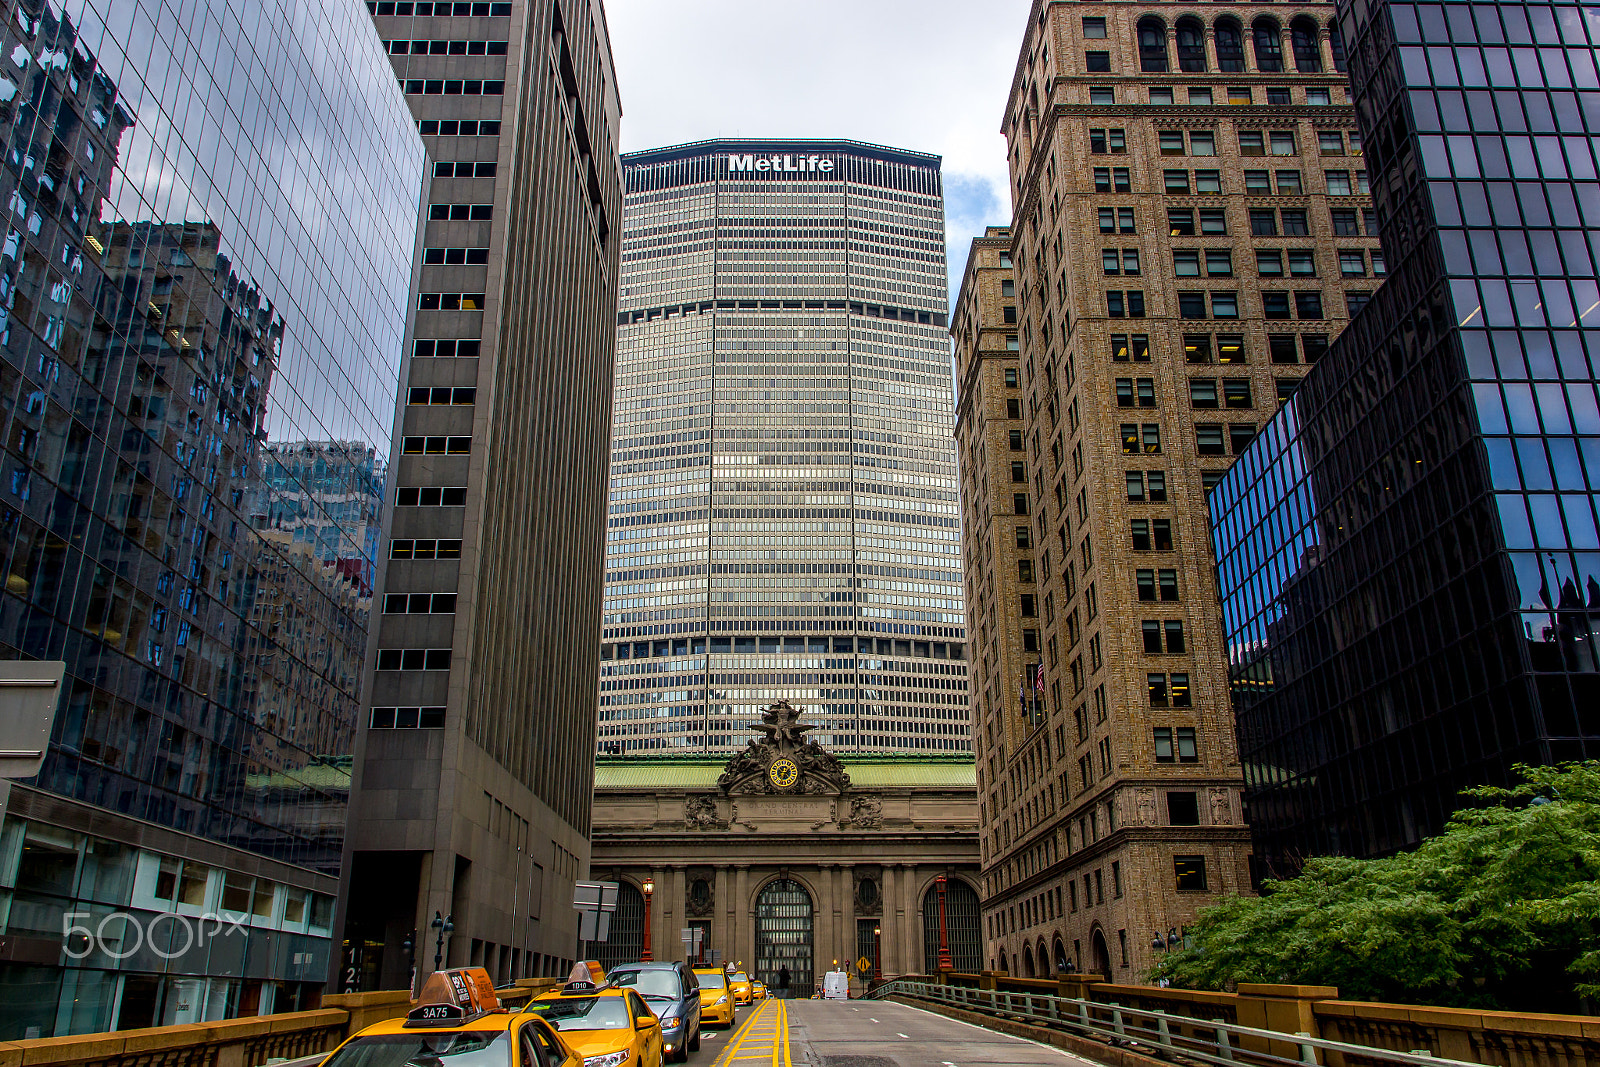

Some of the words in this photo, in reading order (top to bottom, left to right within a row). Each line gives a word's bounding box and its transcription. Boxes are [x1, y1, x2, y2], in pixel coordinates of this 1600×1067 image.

[729, 154, 834, 172] MetLife
[572, 982, 587, 990] 1D10
[423, 1006, 448, 1019] 3A75
